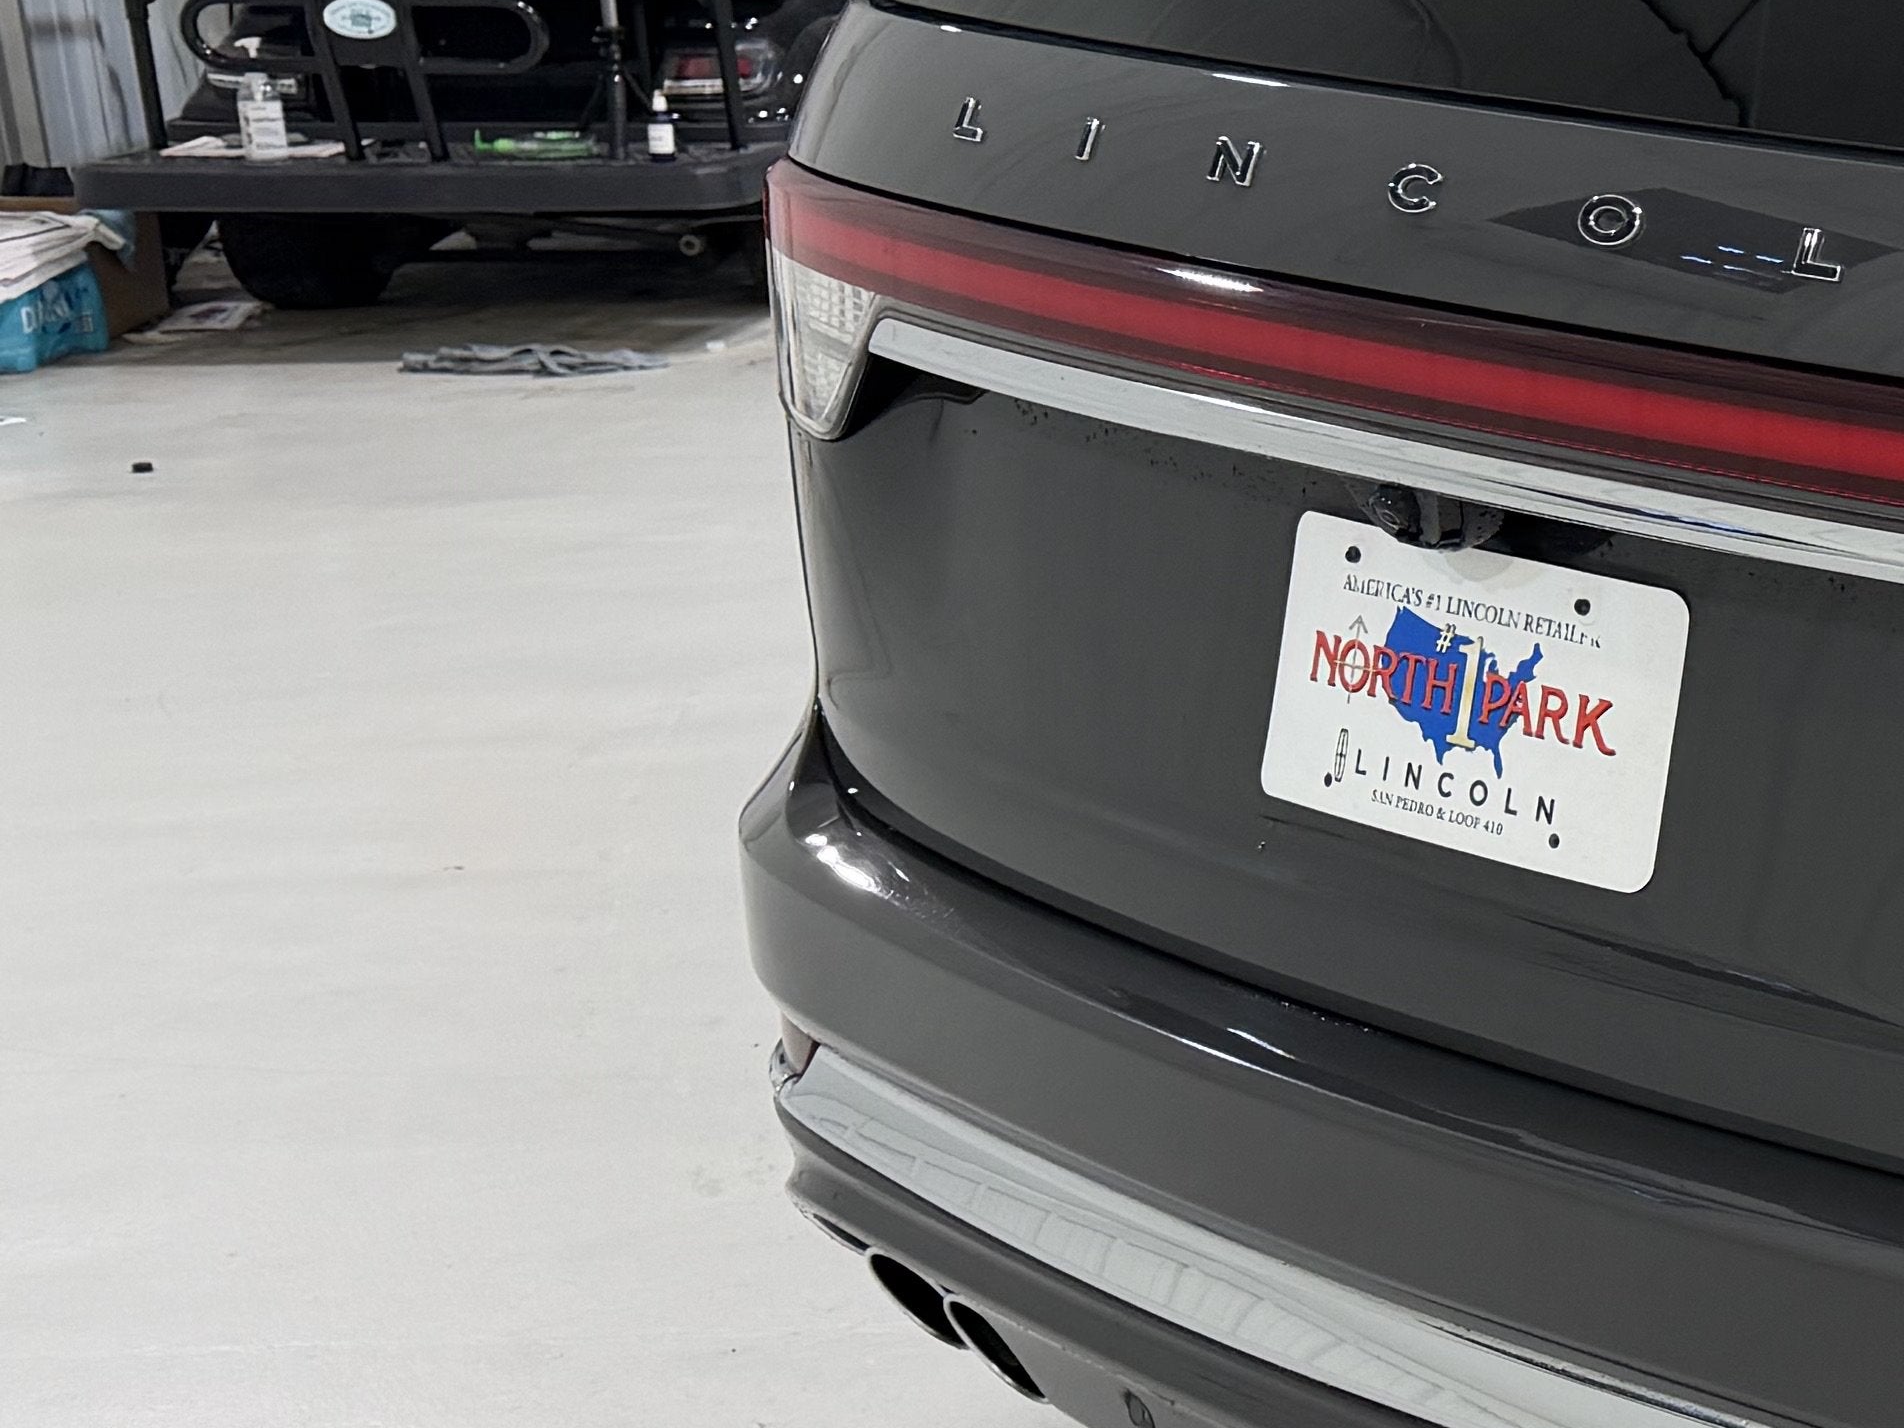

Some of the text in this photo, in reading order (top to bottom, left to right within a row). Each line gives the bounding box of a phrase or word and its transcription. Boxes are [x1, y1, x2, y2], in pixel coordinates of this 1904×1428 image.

[1446, 596, 1523, 629] LINCOLN
[1310, 630, 1617, 756] NORTH PARK
[1355, 748, 1555, 825] LINCOLN
[1395, 795, 1434, 817] PEDRO
[1436, 807, 1446, 820] &
[1483, 820, 1503, 836] 410
